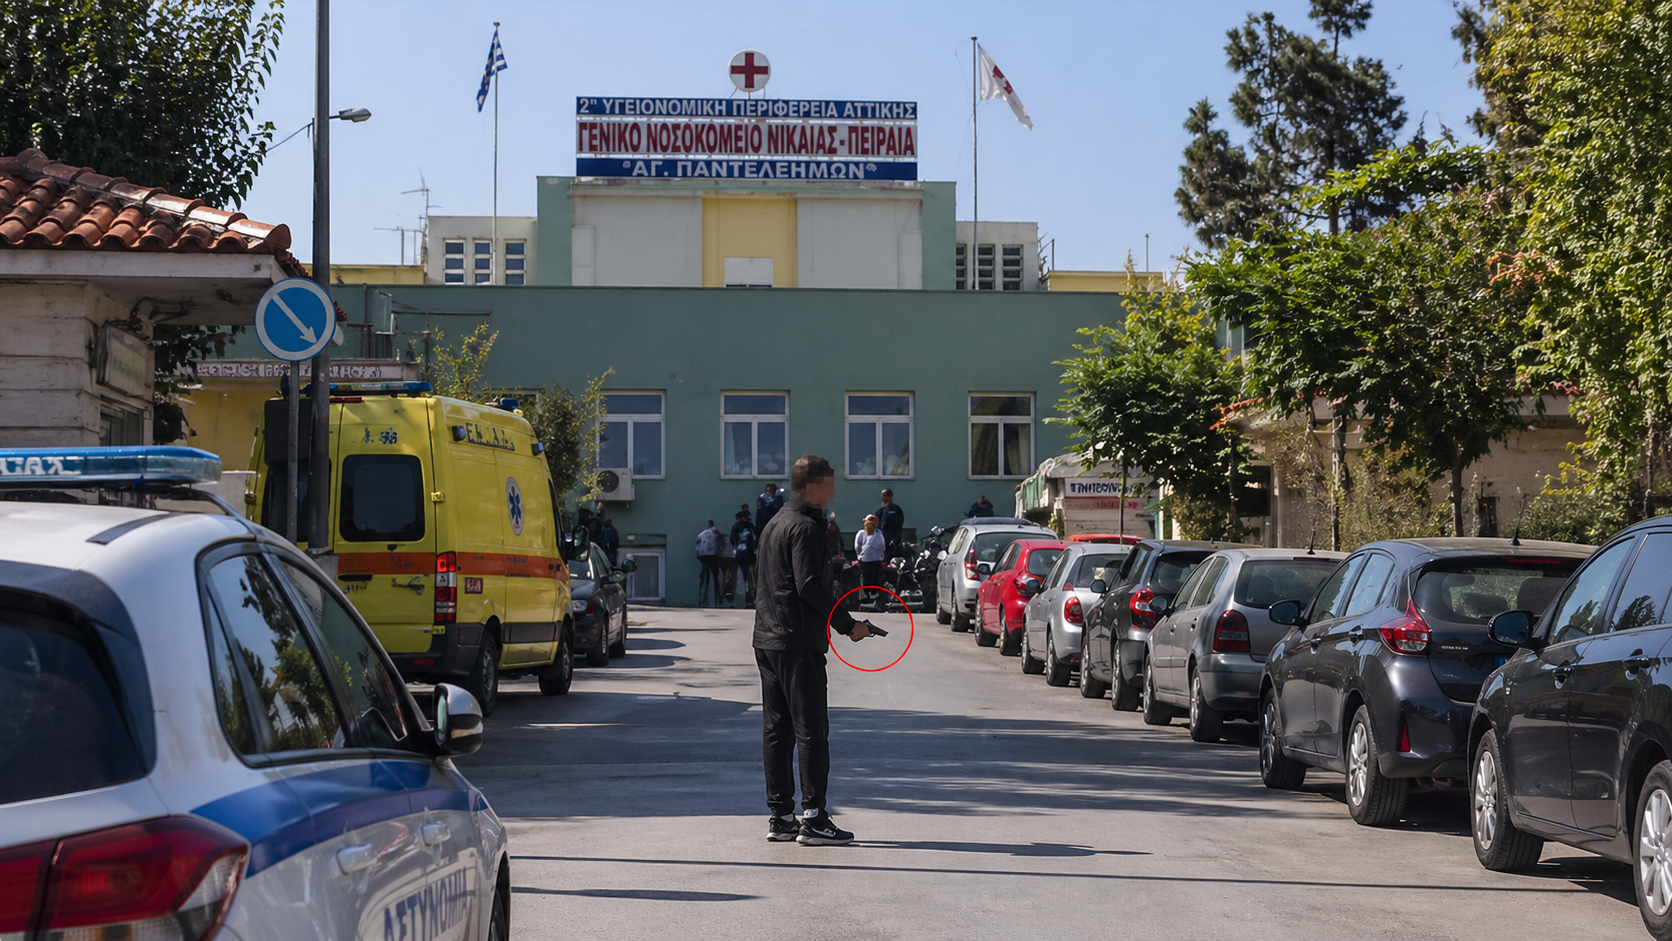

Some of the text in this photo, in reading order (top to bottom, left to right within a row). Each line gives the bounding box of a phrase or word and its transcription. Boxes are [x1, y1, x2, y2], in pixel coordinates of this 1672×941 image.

[602, 98, 727, 116] ΥΓΕΙΟΝΟΜΙΚΗ
[732, 100, 839, 118] ΠΕΡΙΦΕΡΕΙΑ
[843, 102, 916, 119] ΑΤΤΙΚΗΣ
[578, 122, 642, 153] ΓΕΝΙΚΟ
[646, 122, 763, 154] ΝΟΣΟΚΟΜΕΙΟ
